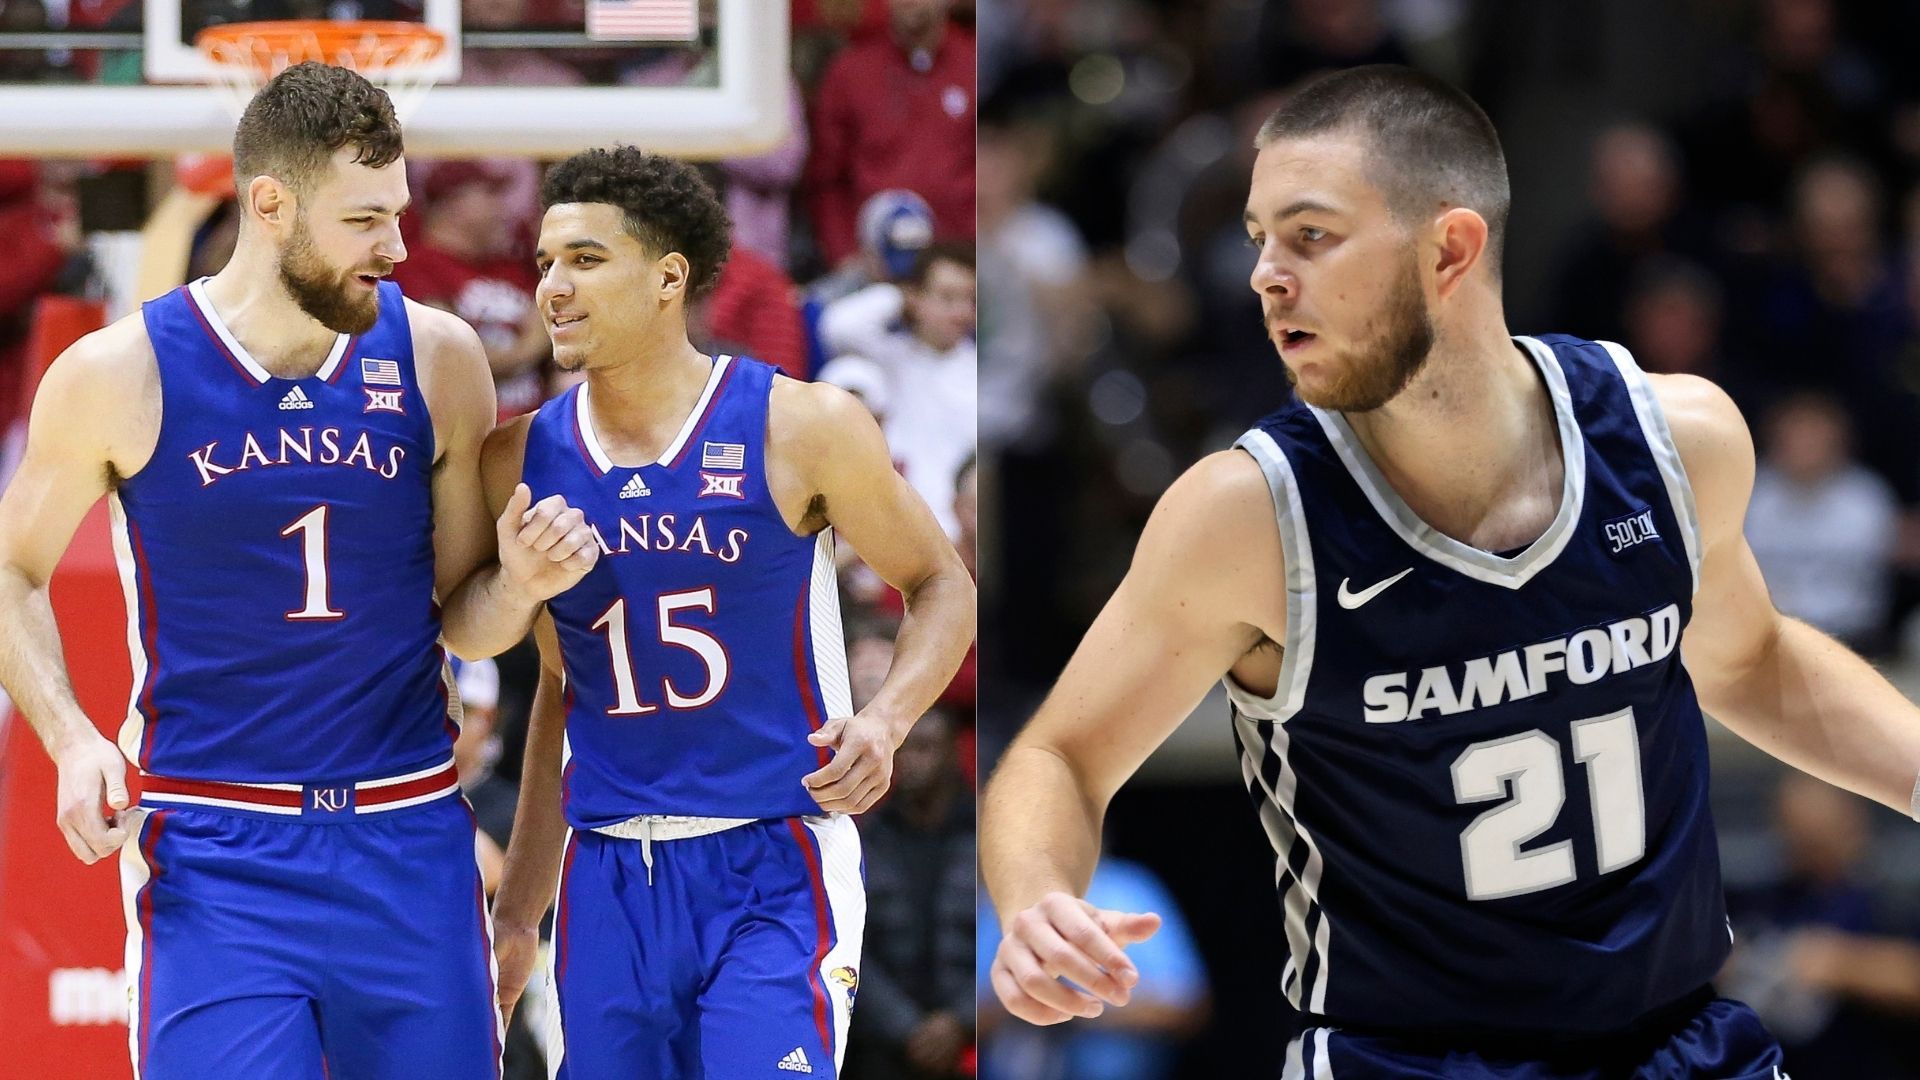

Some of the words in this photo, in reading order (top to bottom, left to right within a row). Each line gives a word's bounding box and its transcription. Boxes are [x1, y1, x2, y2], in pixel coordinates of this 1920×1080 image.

[278, 400, 314, 410] adidas
[187, 427, 405, 487] KANSAS
[619, 487, 651, 499] adidas
[279, 503, 345, 621] 1
[590, 513, 749, 564] ANSAS
[590, 587, 731, 716] 15
[1363, 603, 1681, 724] SAMFORD
[313, 789, 348, 812] KU
[1450, 705, 1646, 901] 21
[777, 1061, 812, 1073] adidas
